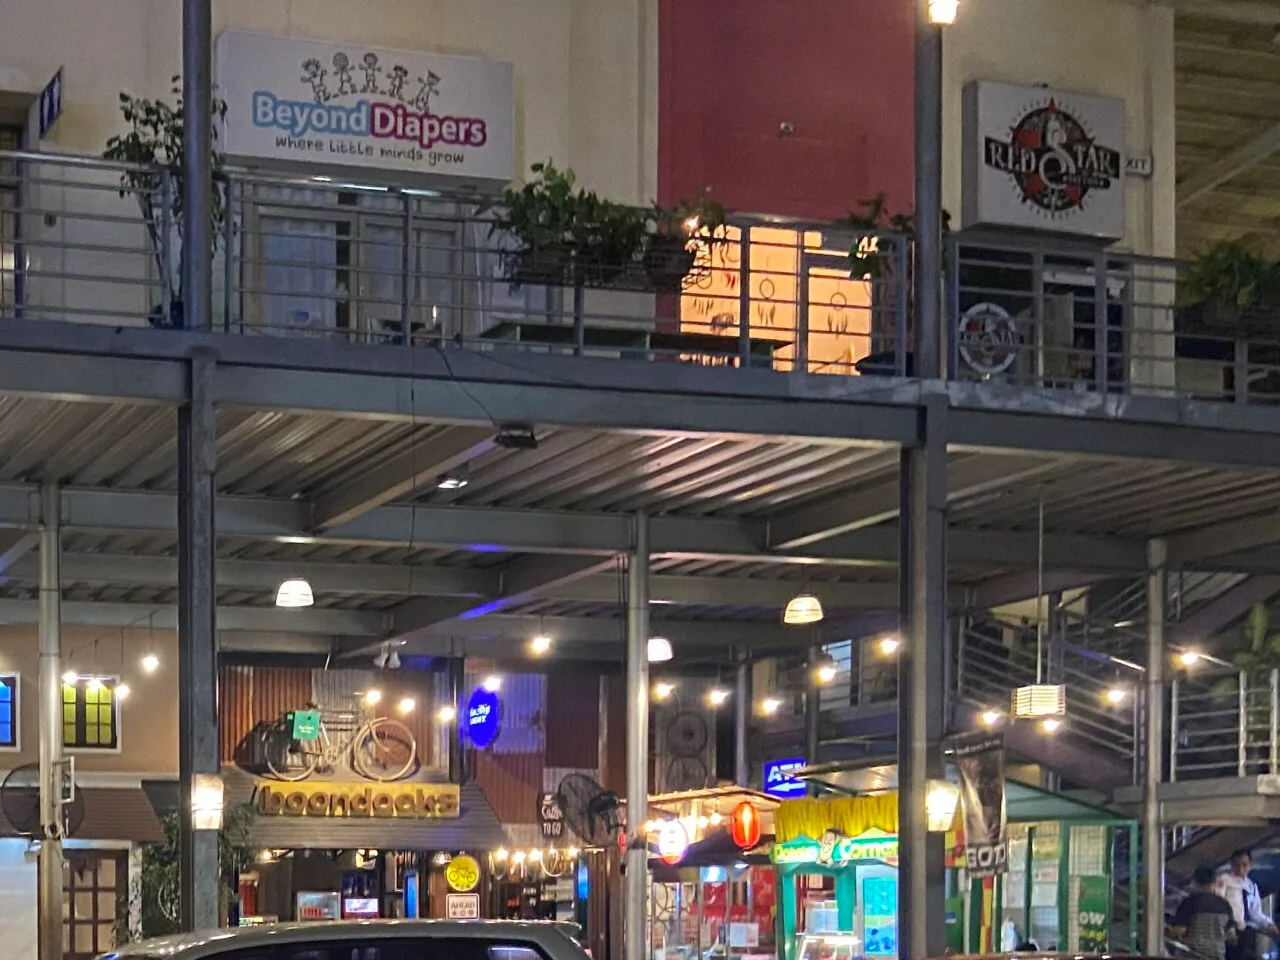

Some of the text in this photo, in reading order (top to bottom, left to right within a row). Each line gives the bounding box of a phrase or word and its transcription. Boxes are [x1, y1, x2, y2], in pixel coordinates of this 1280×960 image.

[253, 91, 487, 148] Beyond Diapers
[275, 136, 324, 151] where
[380, 146, 424, 160] minds
[428, 151, 465, 166] grow
[989, 141, 1036, 173] RED
[1125, 157, 1147, 170] XIT
[450, 902, 476, 910] AHEAD
